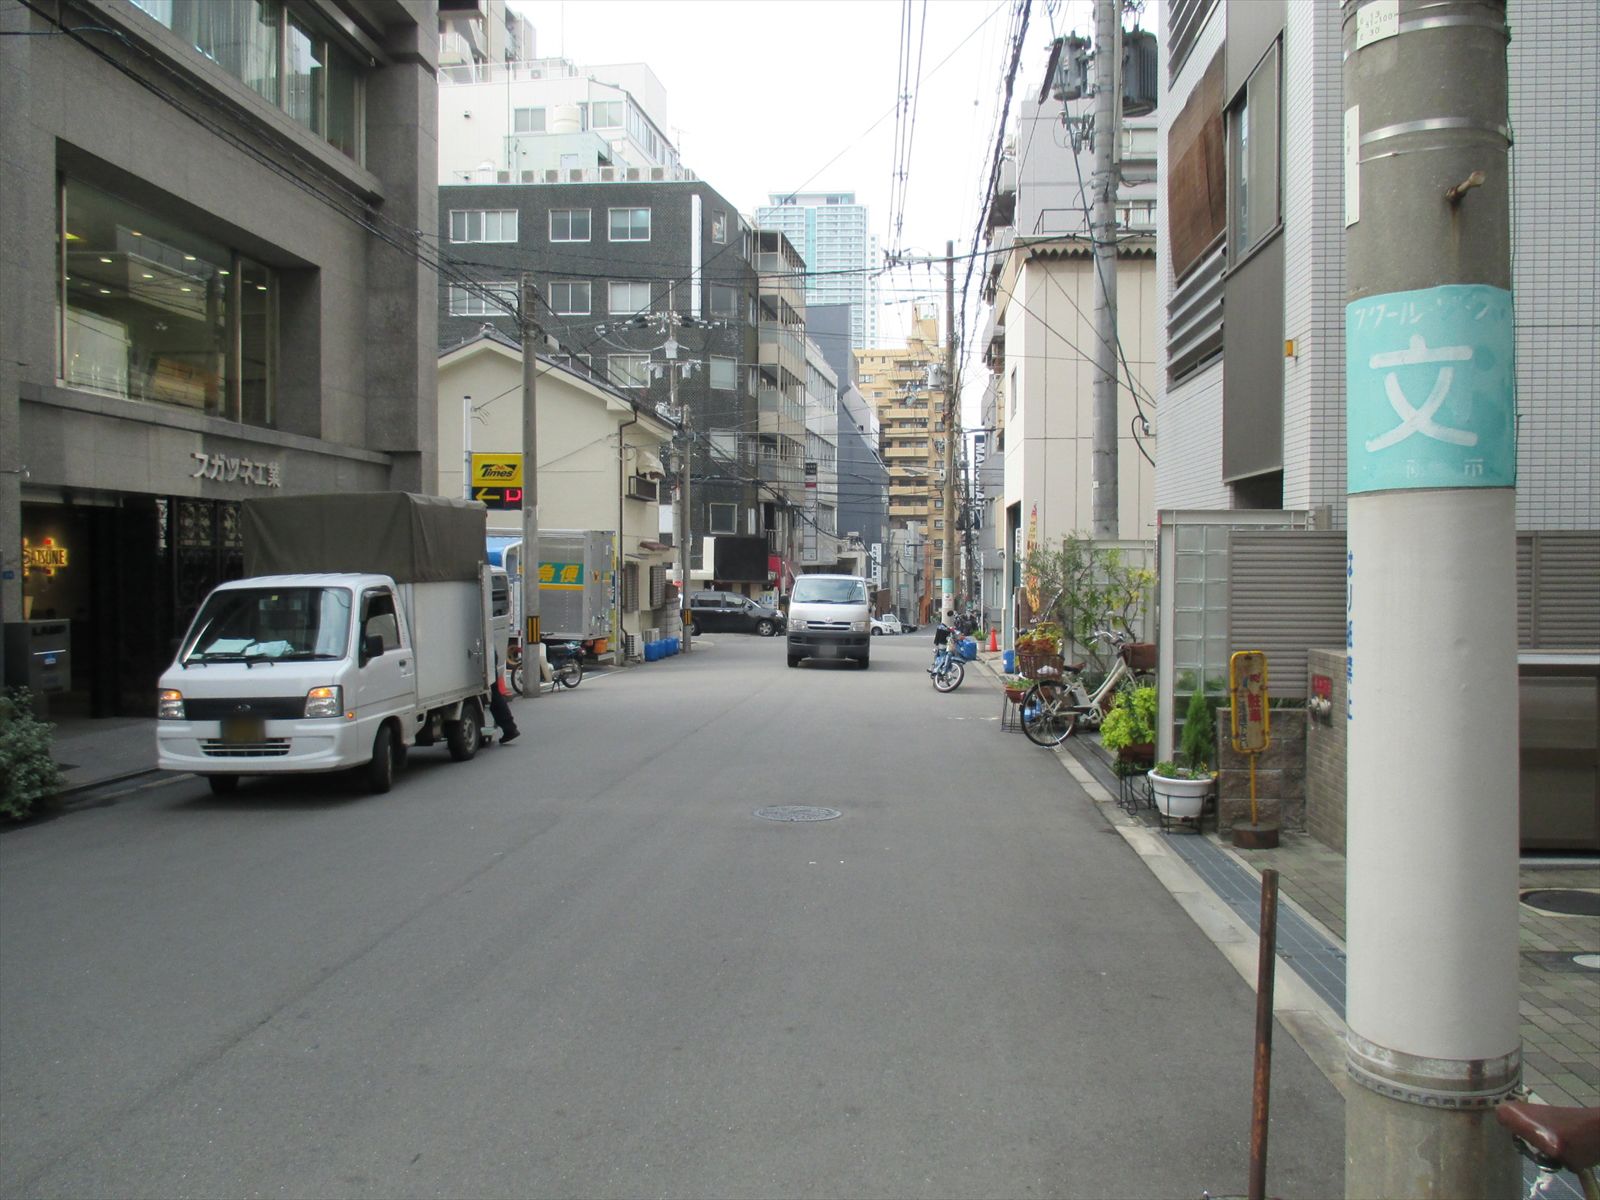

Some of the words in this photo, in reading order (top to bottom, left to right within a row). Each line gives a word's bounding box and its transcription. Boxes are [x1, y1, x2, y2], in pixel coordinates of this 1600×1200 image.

[1365, 334, 1479, 452] 文
[190, 452, 281, 488] スガツネ工業
[480, 464, 518, 477] Times
